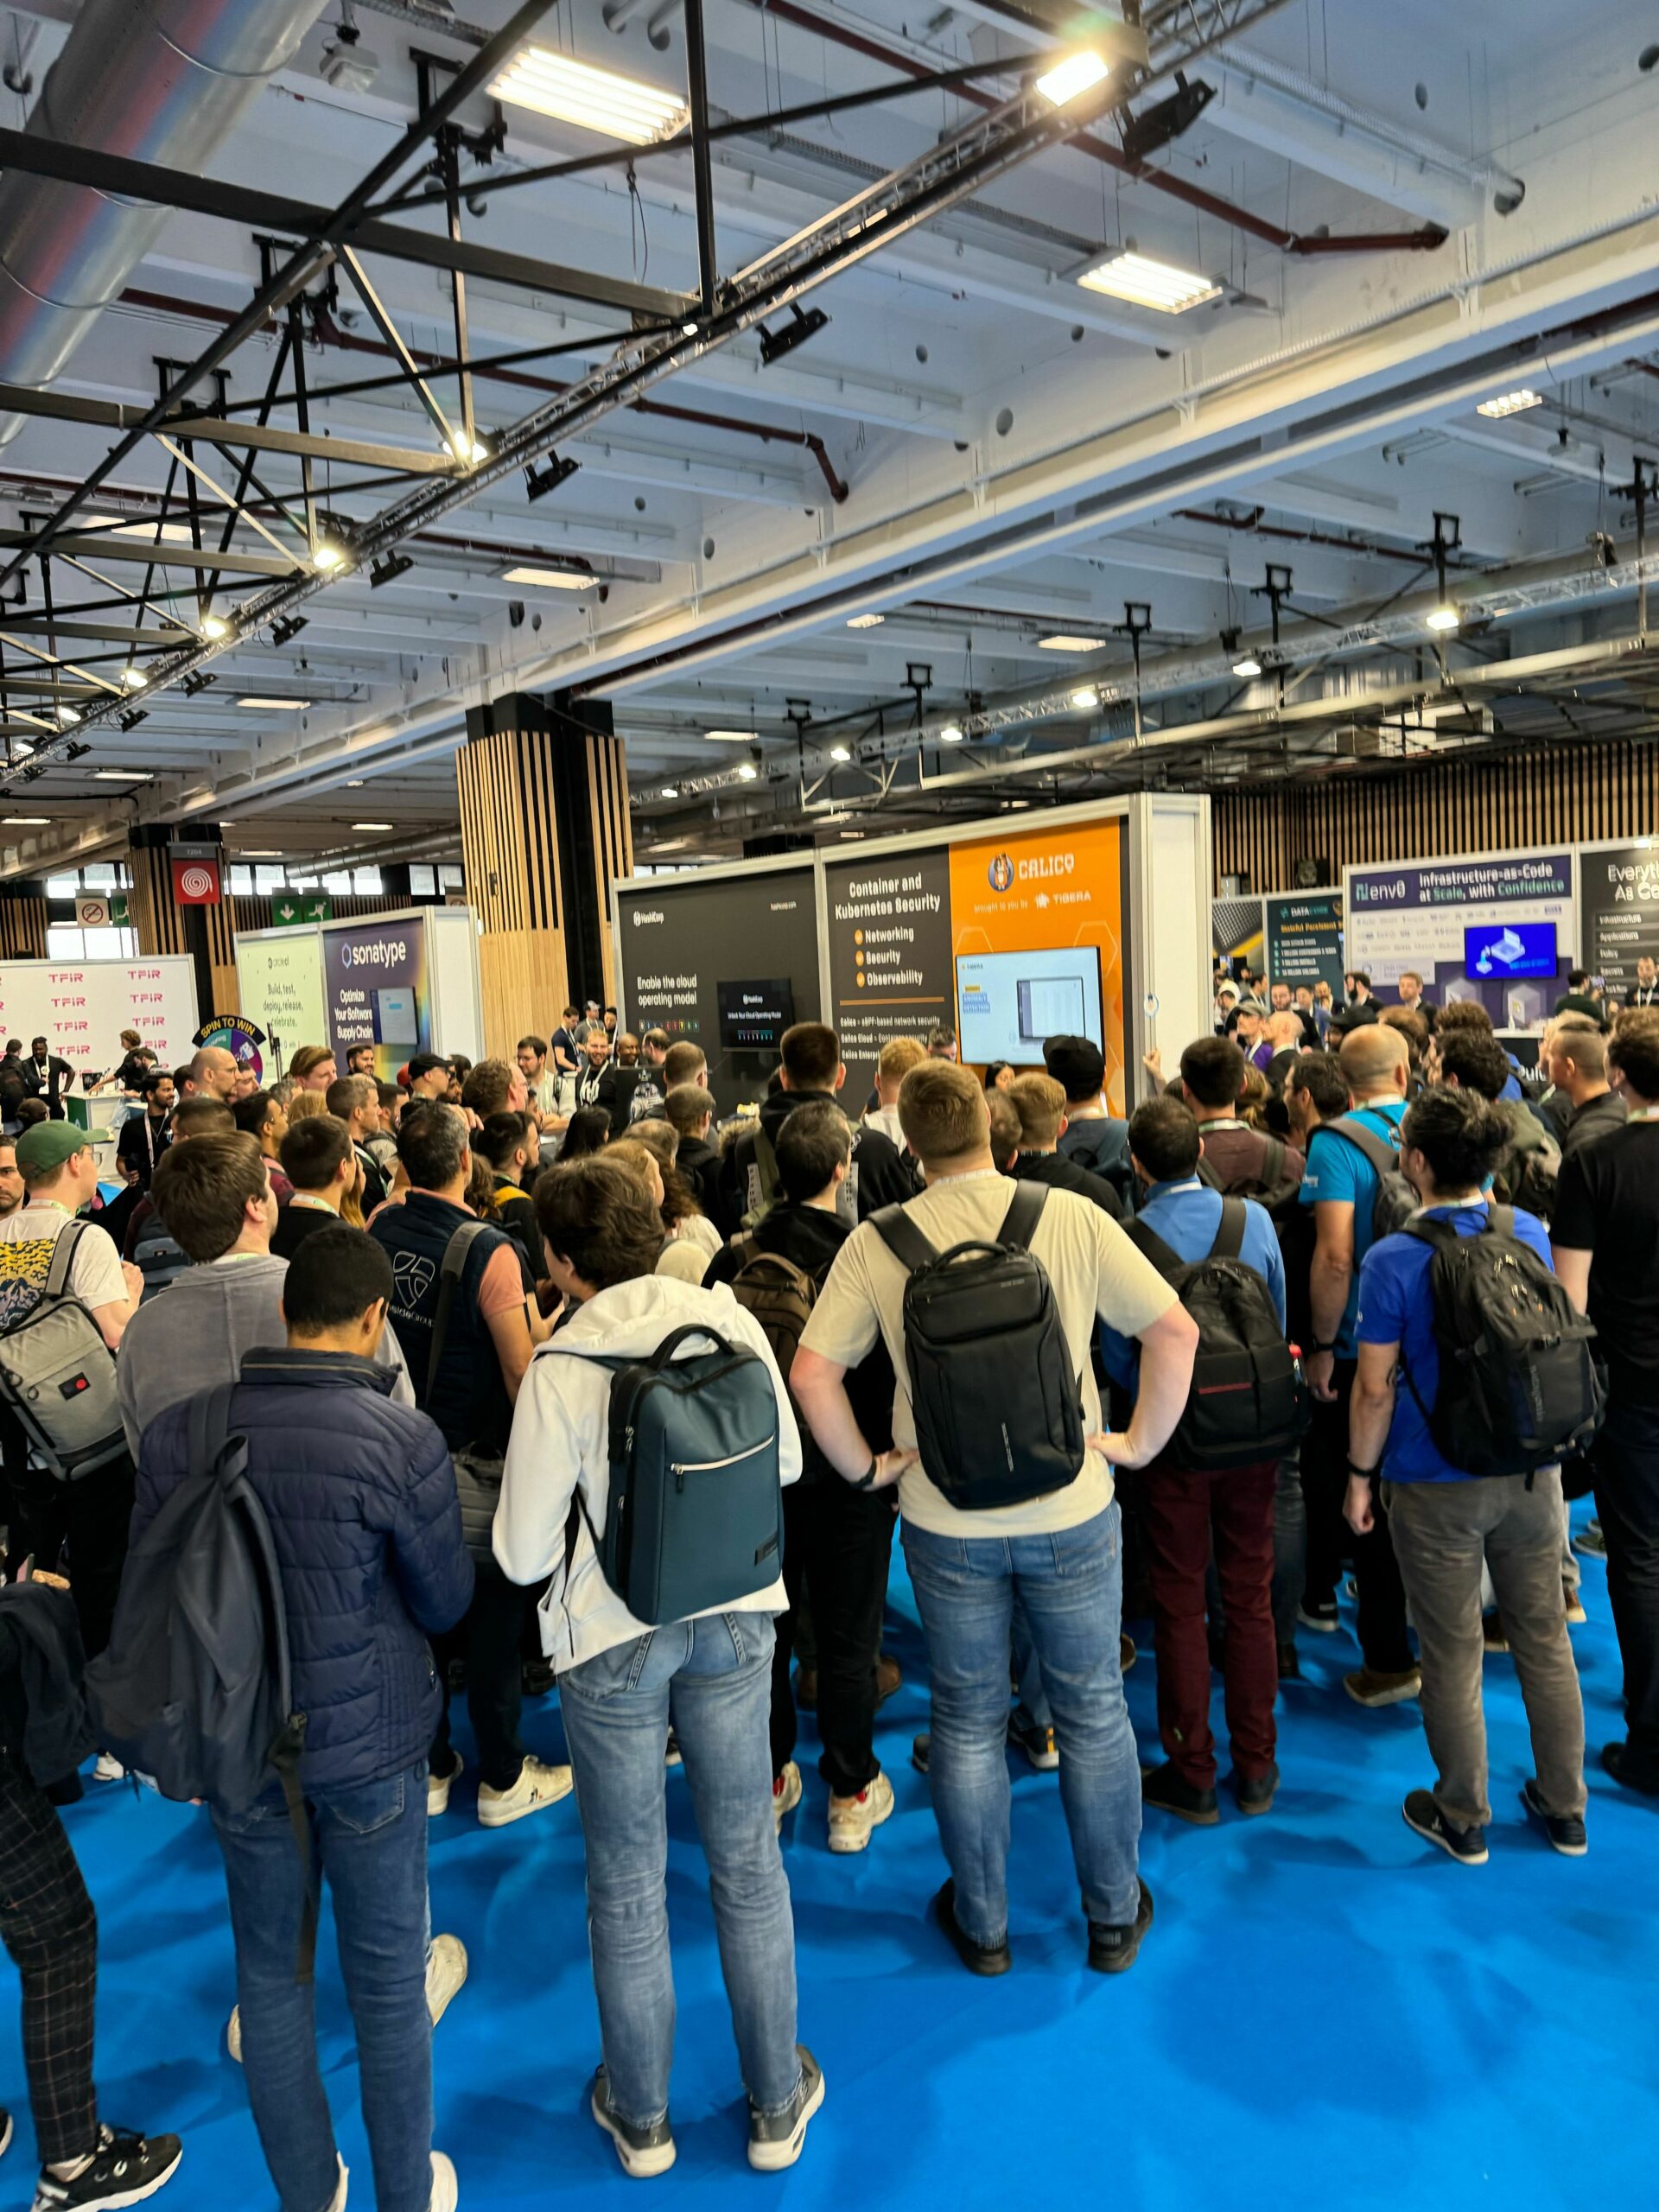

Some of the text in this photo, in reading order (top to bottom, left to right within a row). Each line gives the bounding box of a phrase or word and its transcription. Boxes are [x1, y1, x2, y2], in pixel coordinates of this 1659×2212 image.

[1019, 853, 1074, 880] CALICO
[1420, 862, 1553, 887] Infrastructure-as-Code
[849, 872, 922, 898] Container and
[1420, 878, 1564, 902] at Scale, with Confidence
[1615, 884, 1634, 901] As
[1052, 890, 1091, 905] TIGERA
[835, 893, 940, 920] Kubernetes Security
[865, 926, 914, 944] Networking
[353, 939, 406, 969] sonatype
[866, 949, 900, 965] Security
[637, 973, 696, 990] Enable the cloud
[867, 969, 923, 986] Observability
[268, 983, 296, 996] Build, test,
[340, 988, 365, 1006] Optimize
[263, 998, 303, 1014] deploy, release,
[639, 991, 696, 1008] operating model
[334, 1007, 372, 1021] Your Software
[840, 1017, 856, 1027] Calico
[893, 1015, 916, 1027] network
[918, 1015, 940, 1027] security
[200, 1017, 256, 1038] SPIN TO WIN
[337, 1025, 373, 1041] Supply Chain
[841, 1033, 857, 1043] Calico
